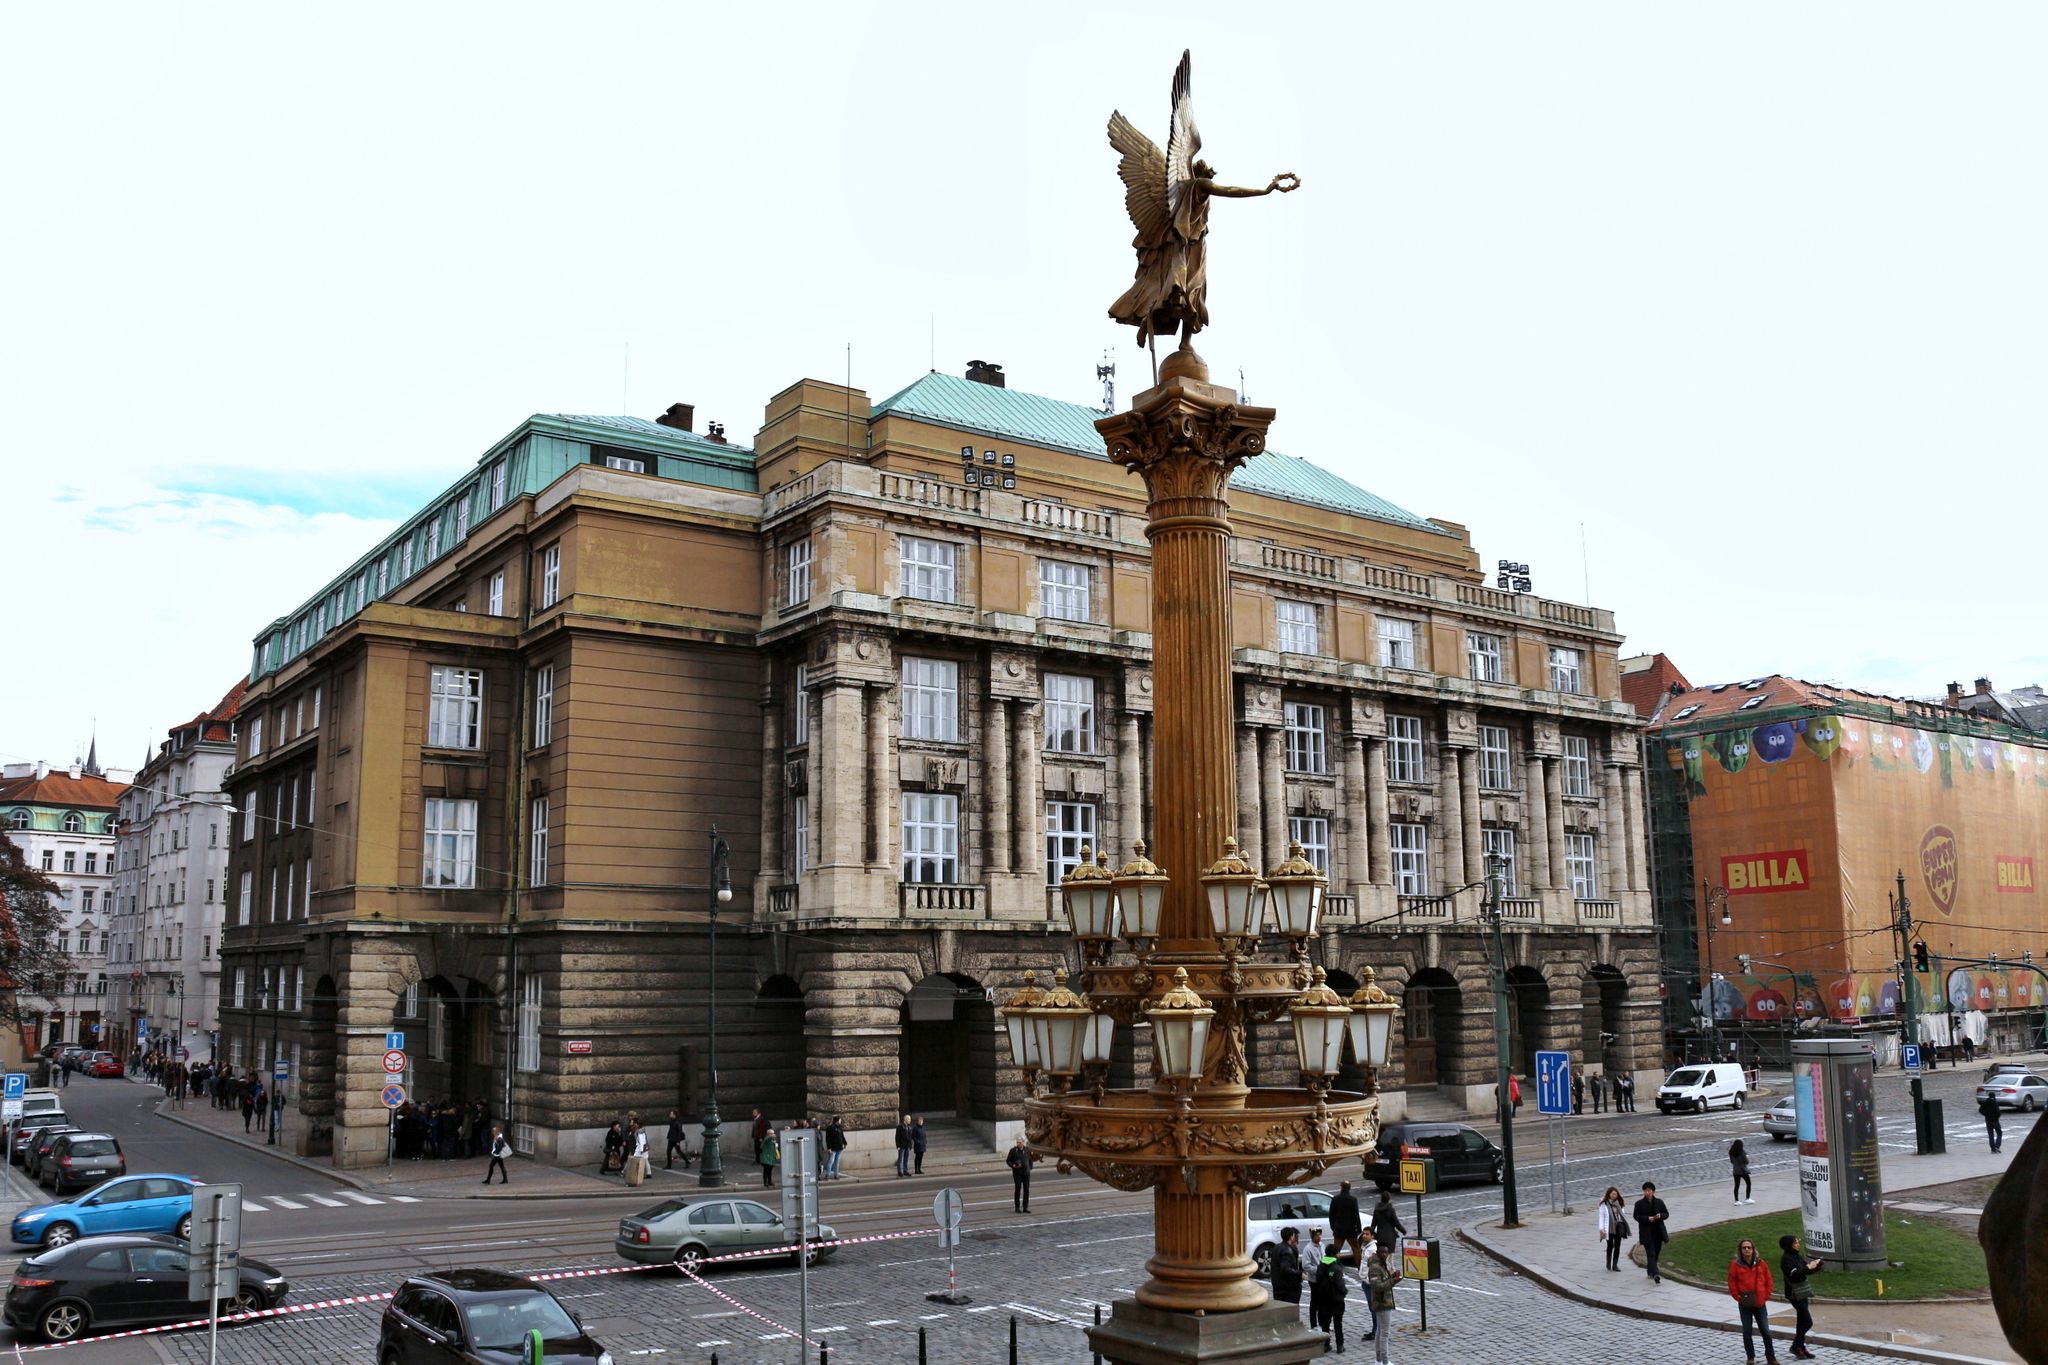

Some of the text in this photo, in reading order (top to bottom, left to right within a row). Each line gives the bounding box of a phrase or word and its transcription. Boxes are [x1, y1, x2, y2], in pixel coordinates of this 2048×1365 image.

[1727, 858, 1804, 889] BILLA
[1998, 862, 2032, 888] BILLA
[1906, 1047, 1916, 1062] P
[9, 1077, 21, 1091] P
[1812, 1164, 1828, 1173] LONI
[1405, 1171, 1420, 1182] TAXI
[1814, 1230, 1832, 1241] YEAR
